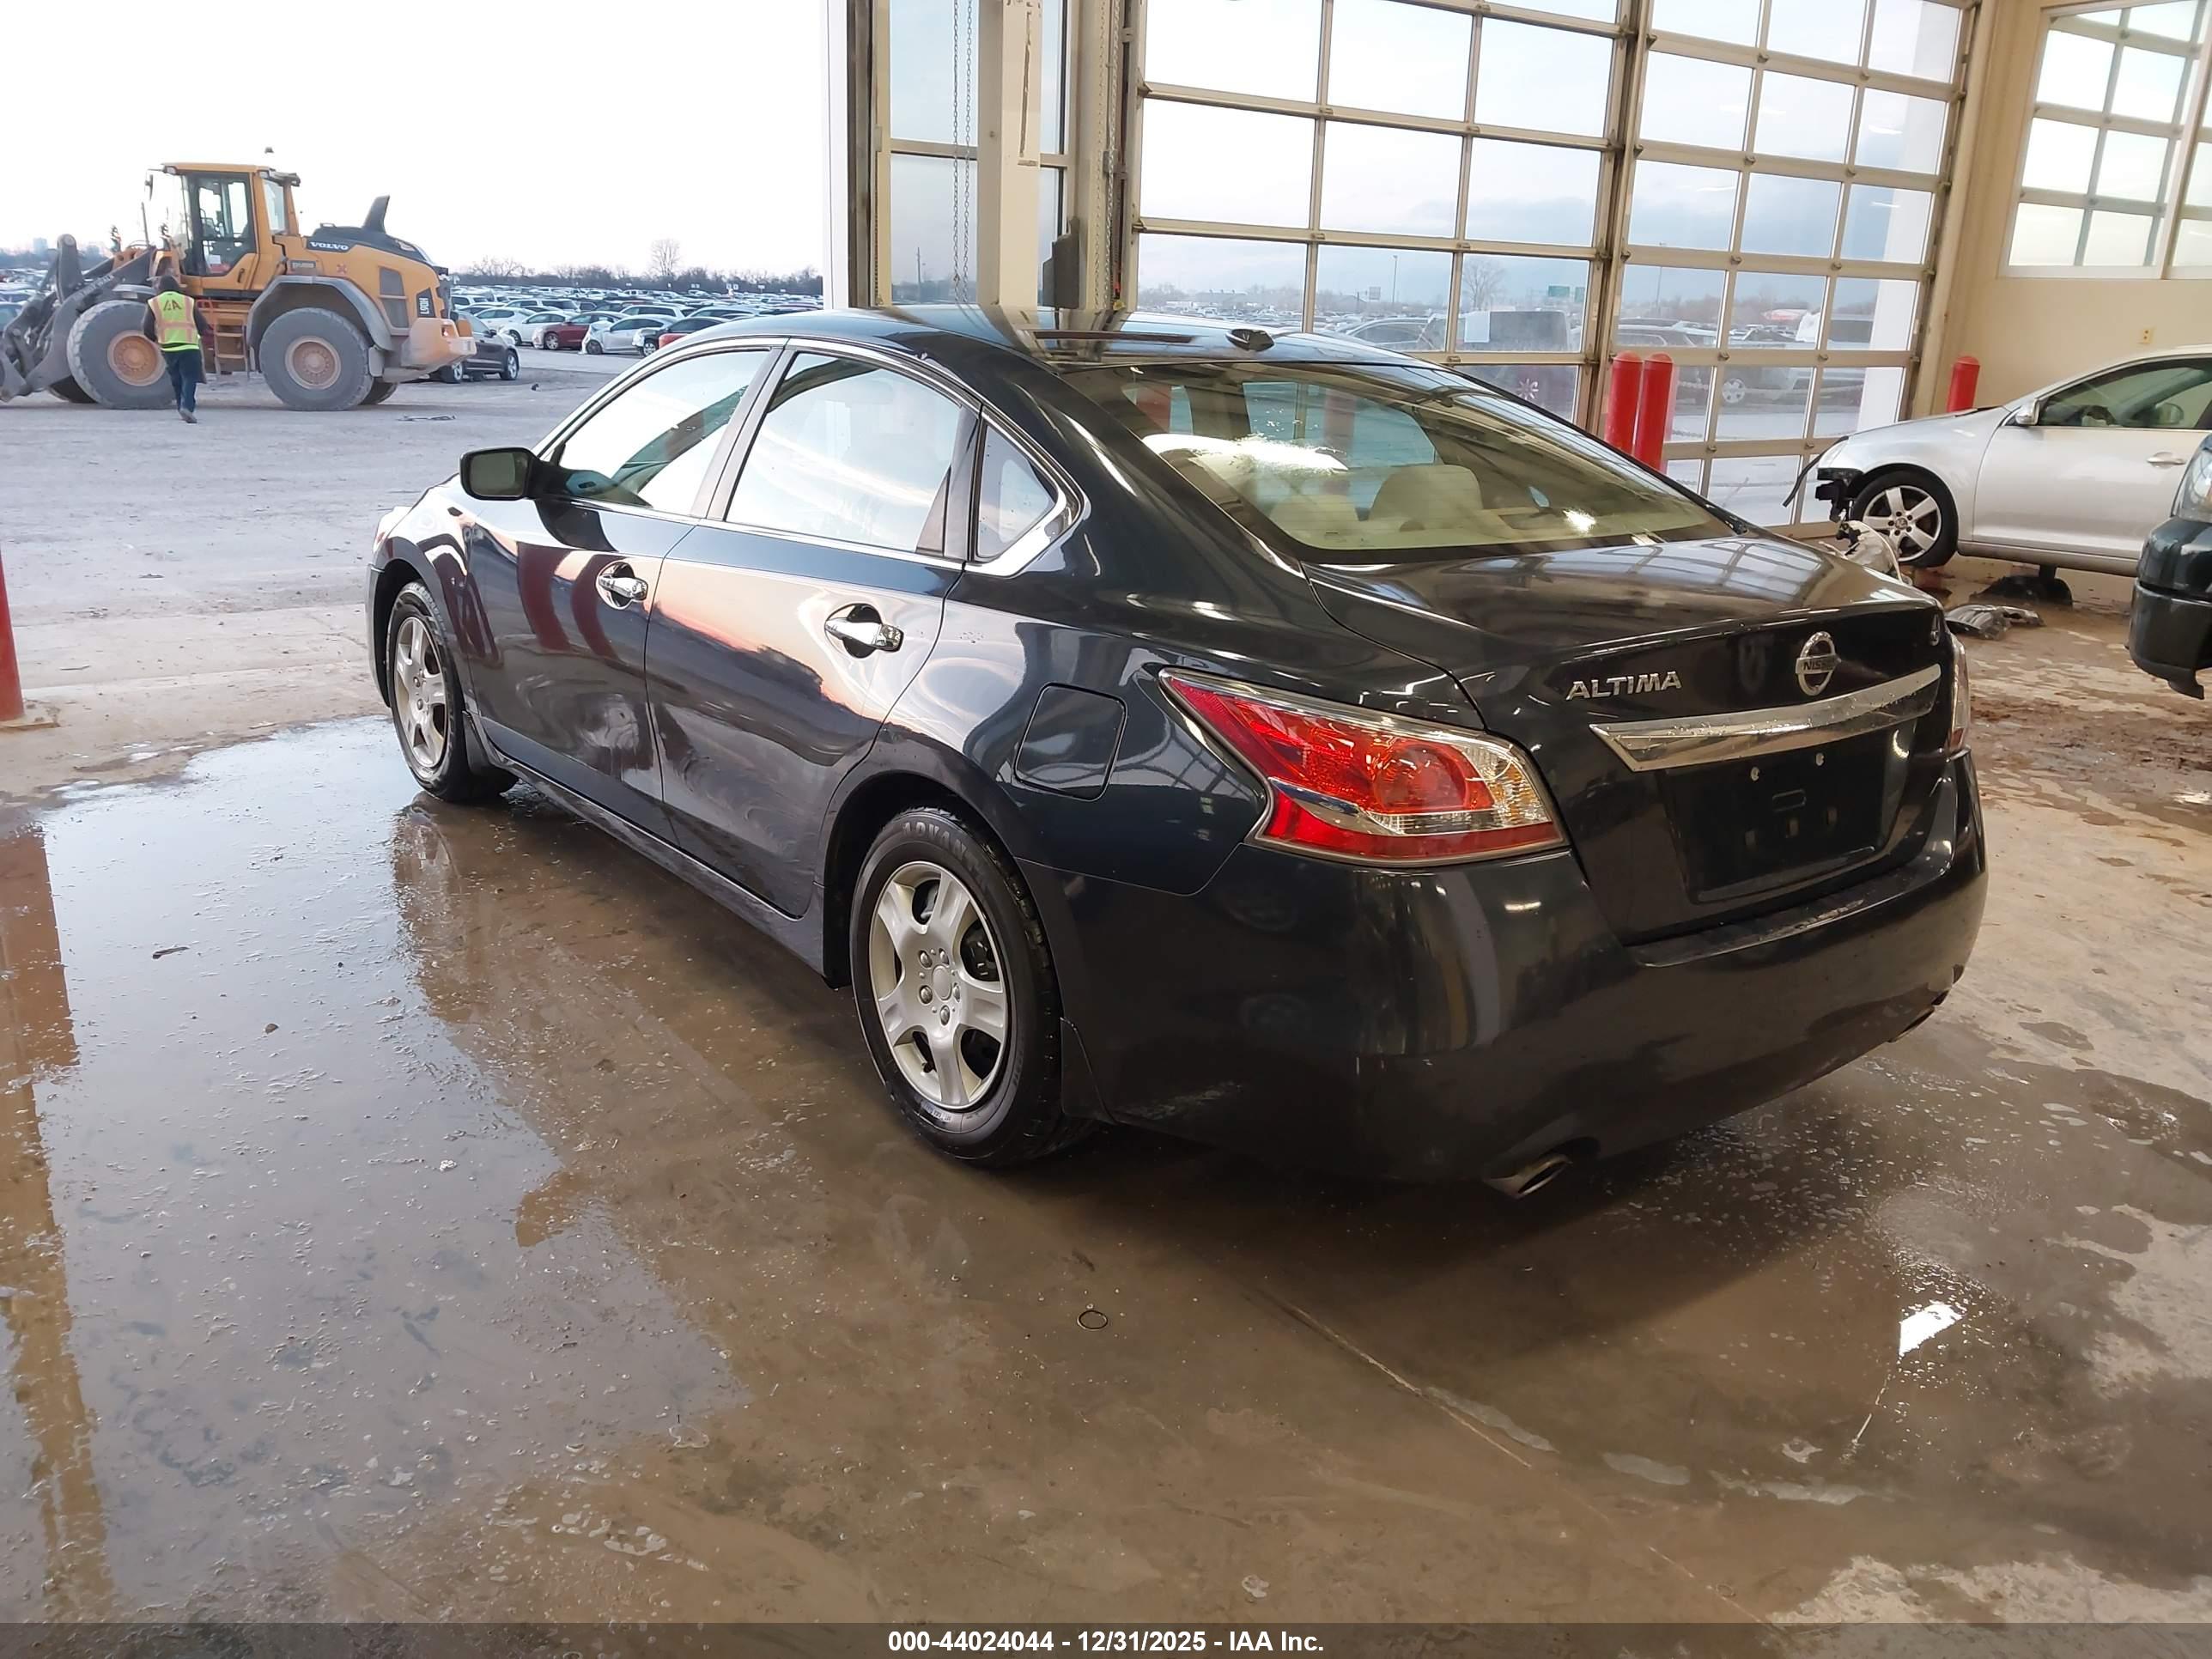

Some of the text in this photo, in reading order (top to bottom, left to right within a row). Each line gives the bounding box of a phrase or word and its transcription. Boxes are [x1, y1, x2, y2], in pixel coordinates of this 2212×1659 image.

[310, 241, 349, 251] VOLVO
[1803, 657, 1833, 671] NISS
[1565, 671, 1682, 701] ALTIMA
